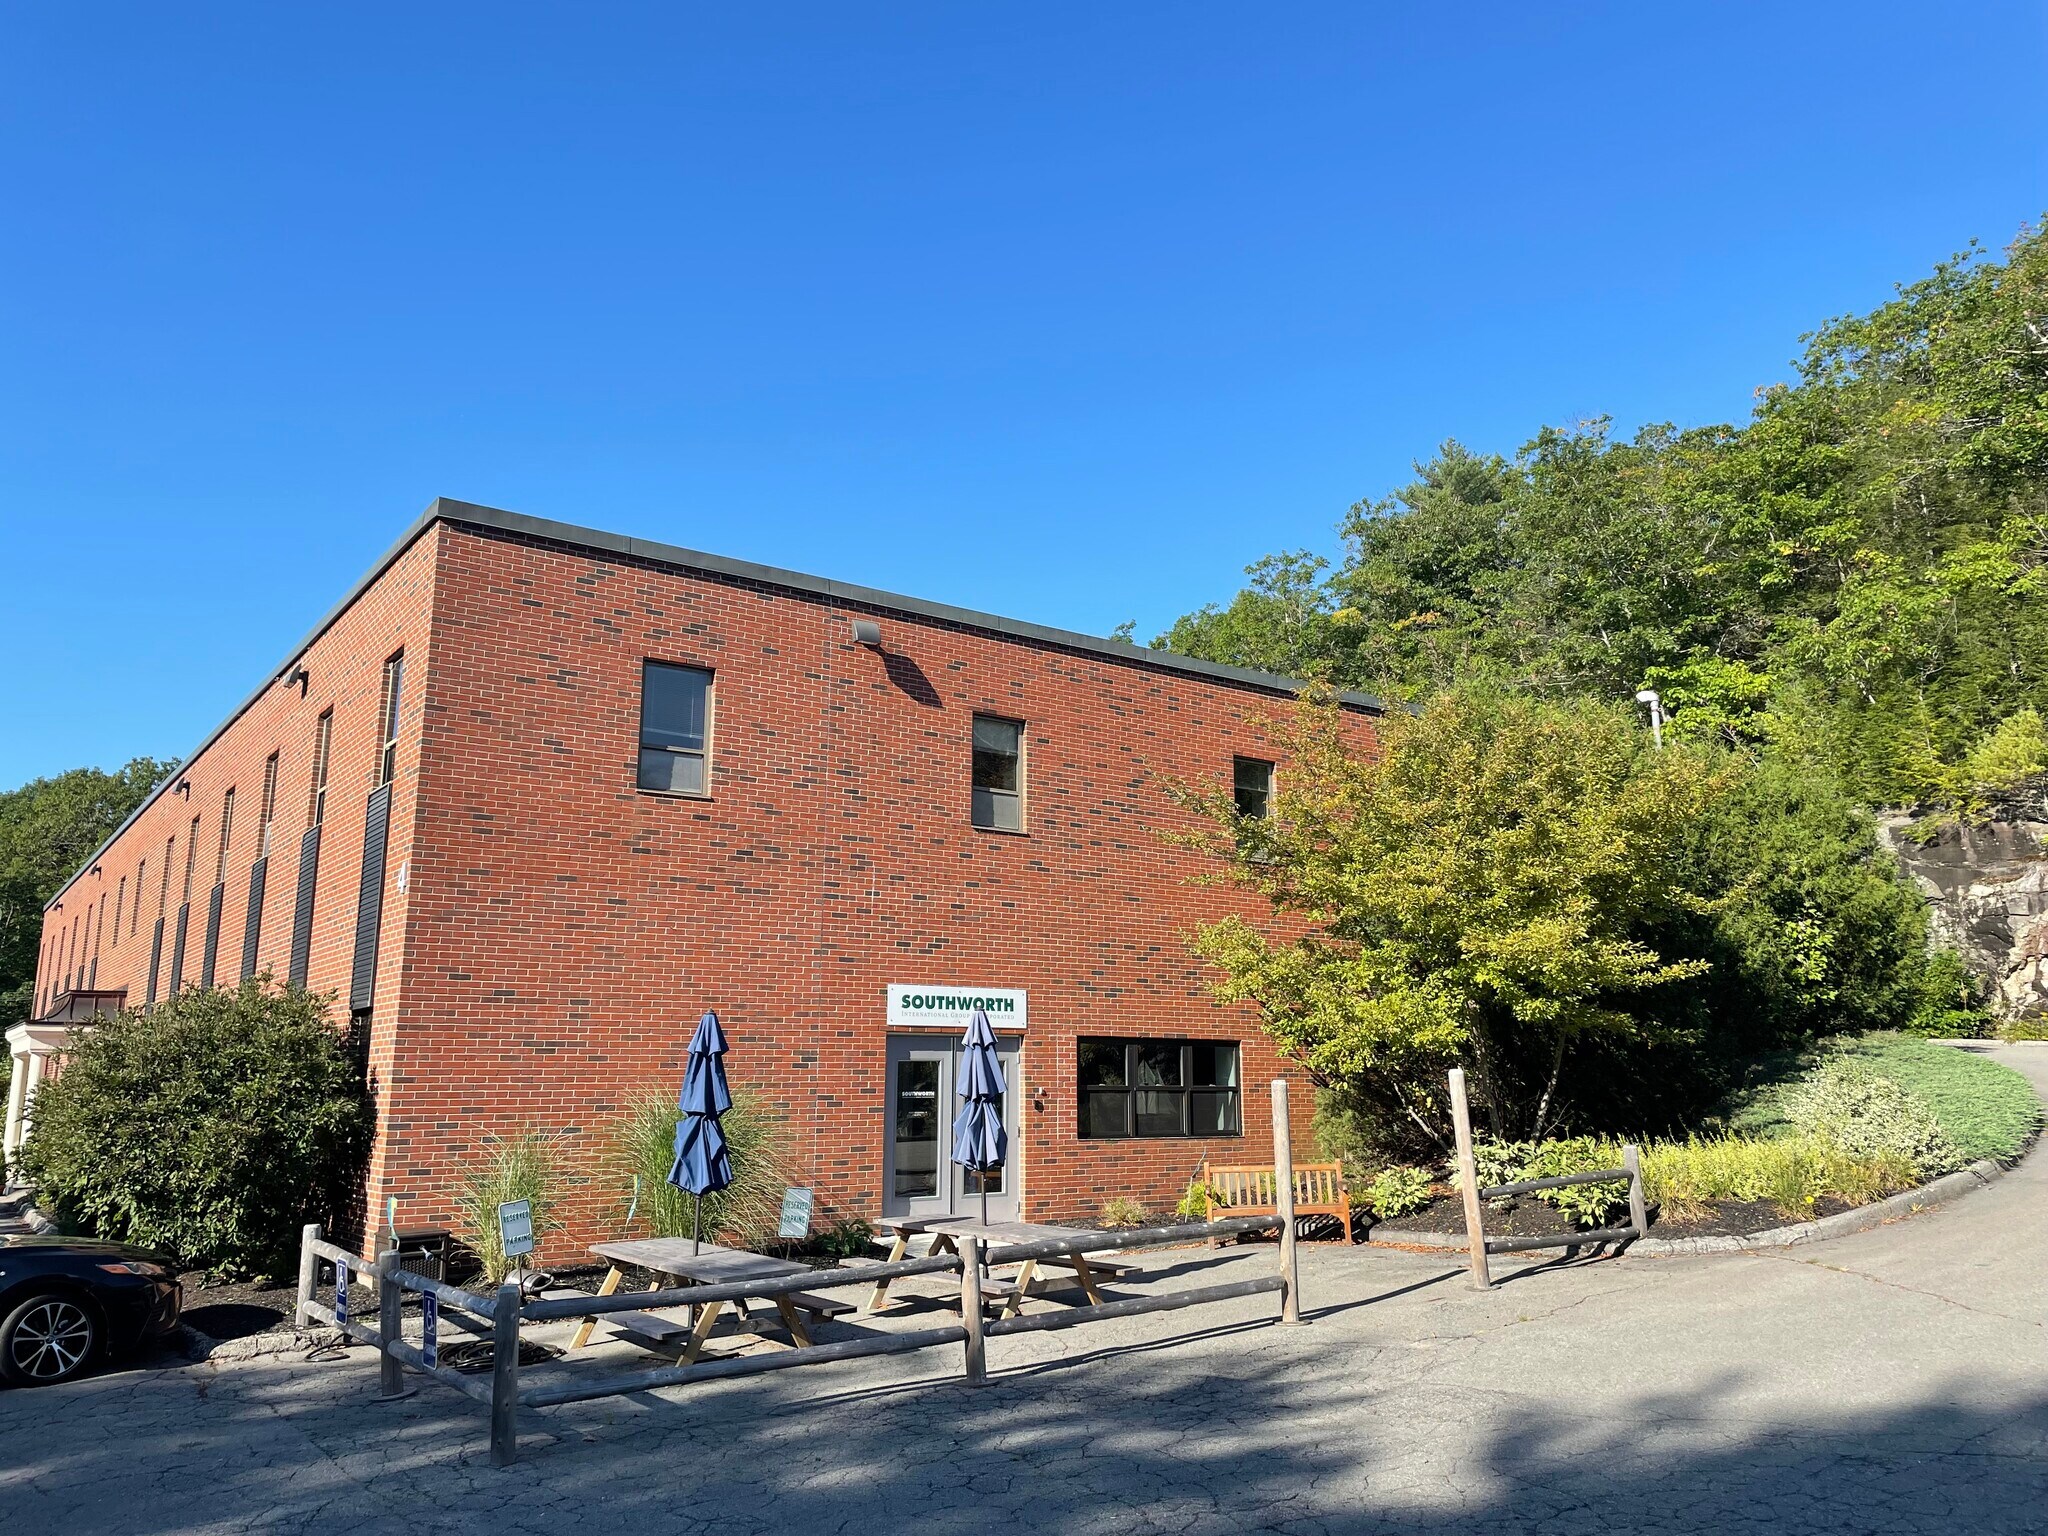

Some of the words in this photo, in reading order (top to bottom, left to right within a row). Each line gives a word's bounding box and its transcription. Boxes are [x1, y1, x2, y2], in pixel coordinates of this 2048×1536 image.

[901, 994, 1014, 1012] SOUTHWORTH
[784, 1200, 809, 1210] RESERVED
[503, 1210, 529, 1223] RESERVED
[506, 1233, 531, 1246] PARKING
